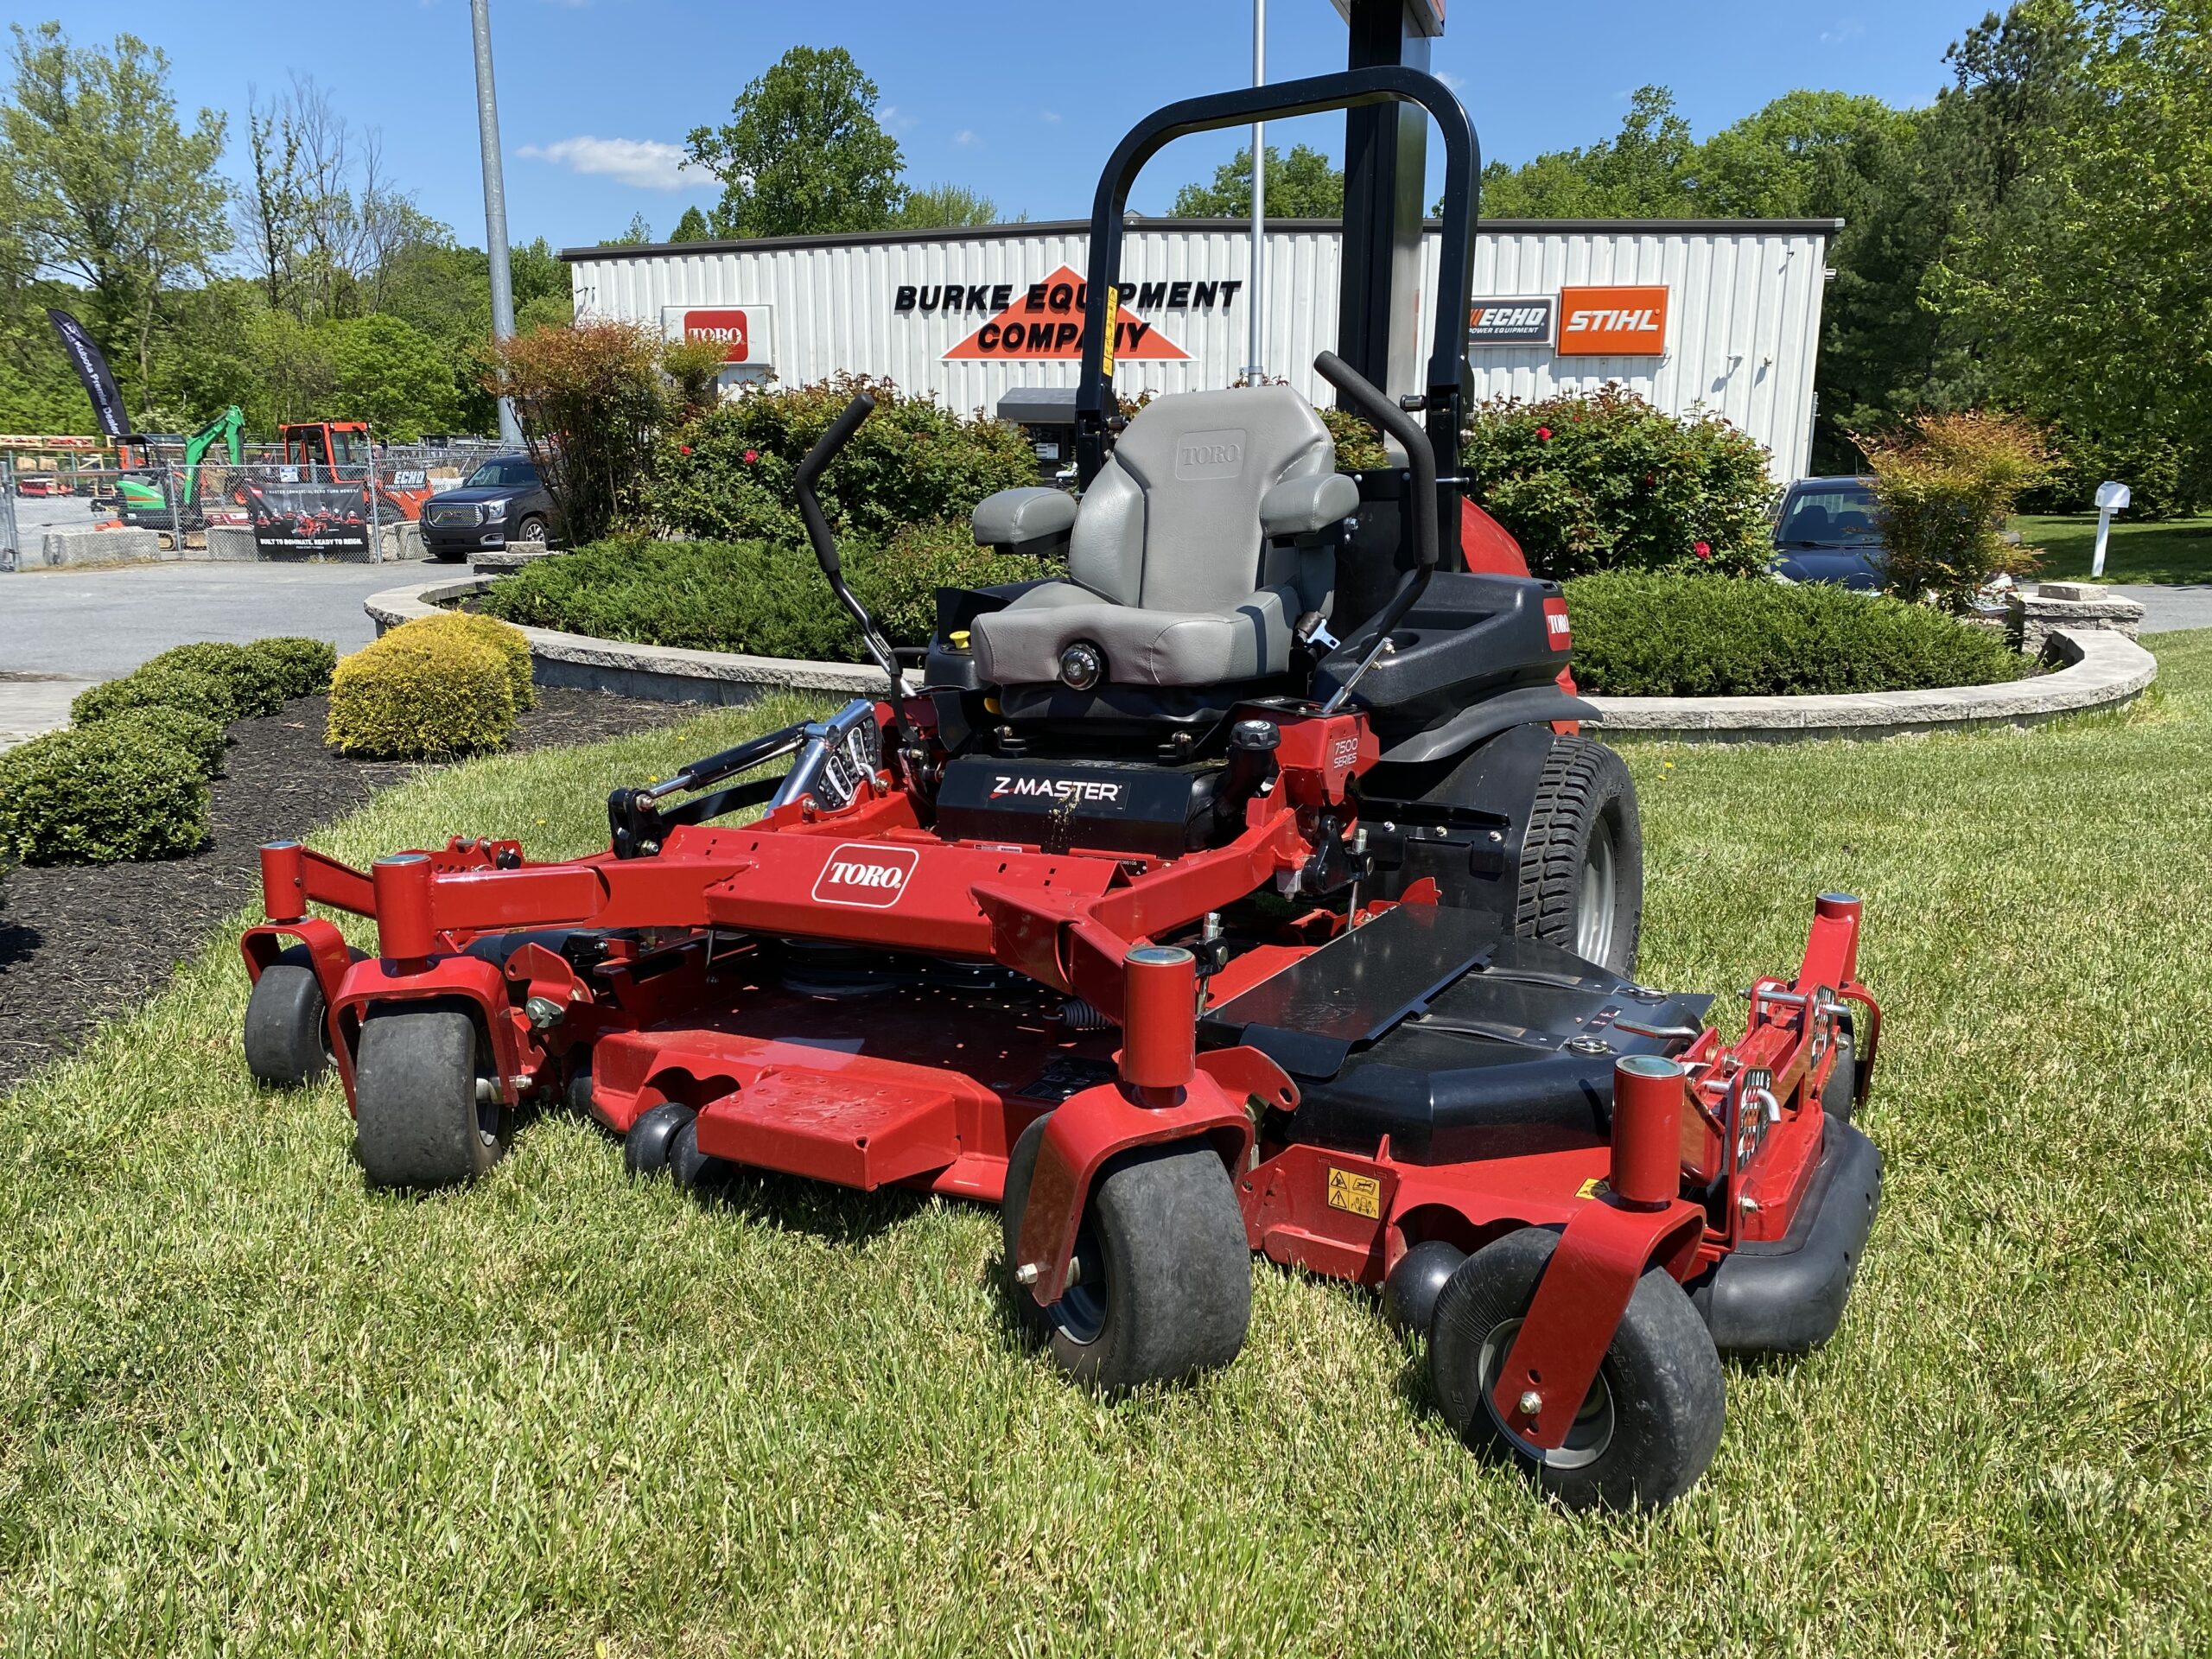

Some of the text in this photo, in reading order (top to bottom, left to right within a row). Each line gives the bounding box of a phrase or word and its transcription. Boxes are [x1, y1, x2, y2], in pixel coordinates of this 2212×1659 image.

[894, 281, 1242, 311] BURKE EQPMENT
[1478, 308, 1547, 327] ECHO
[1565, 310, 1659, 333] STIHL
[688, 327, 742, 345] TORO
[978, 322, 1151, 349] COMPY
[74, 340, 121, 435] Kubota Premier Dealer
[1181, 443, 1240, 466] TORO
[394, 471, 425, 484] ECHO
[1548, 614, 1571, 633] TORO
[1334, 738, 1358, 755] 7500
[1333, 753, 1357, 768] SERIES
[994, 777, 1118, 801] Z MASTER
[828, 862, 902, 888] TORO
